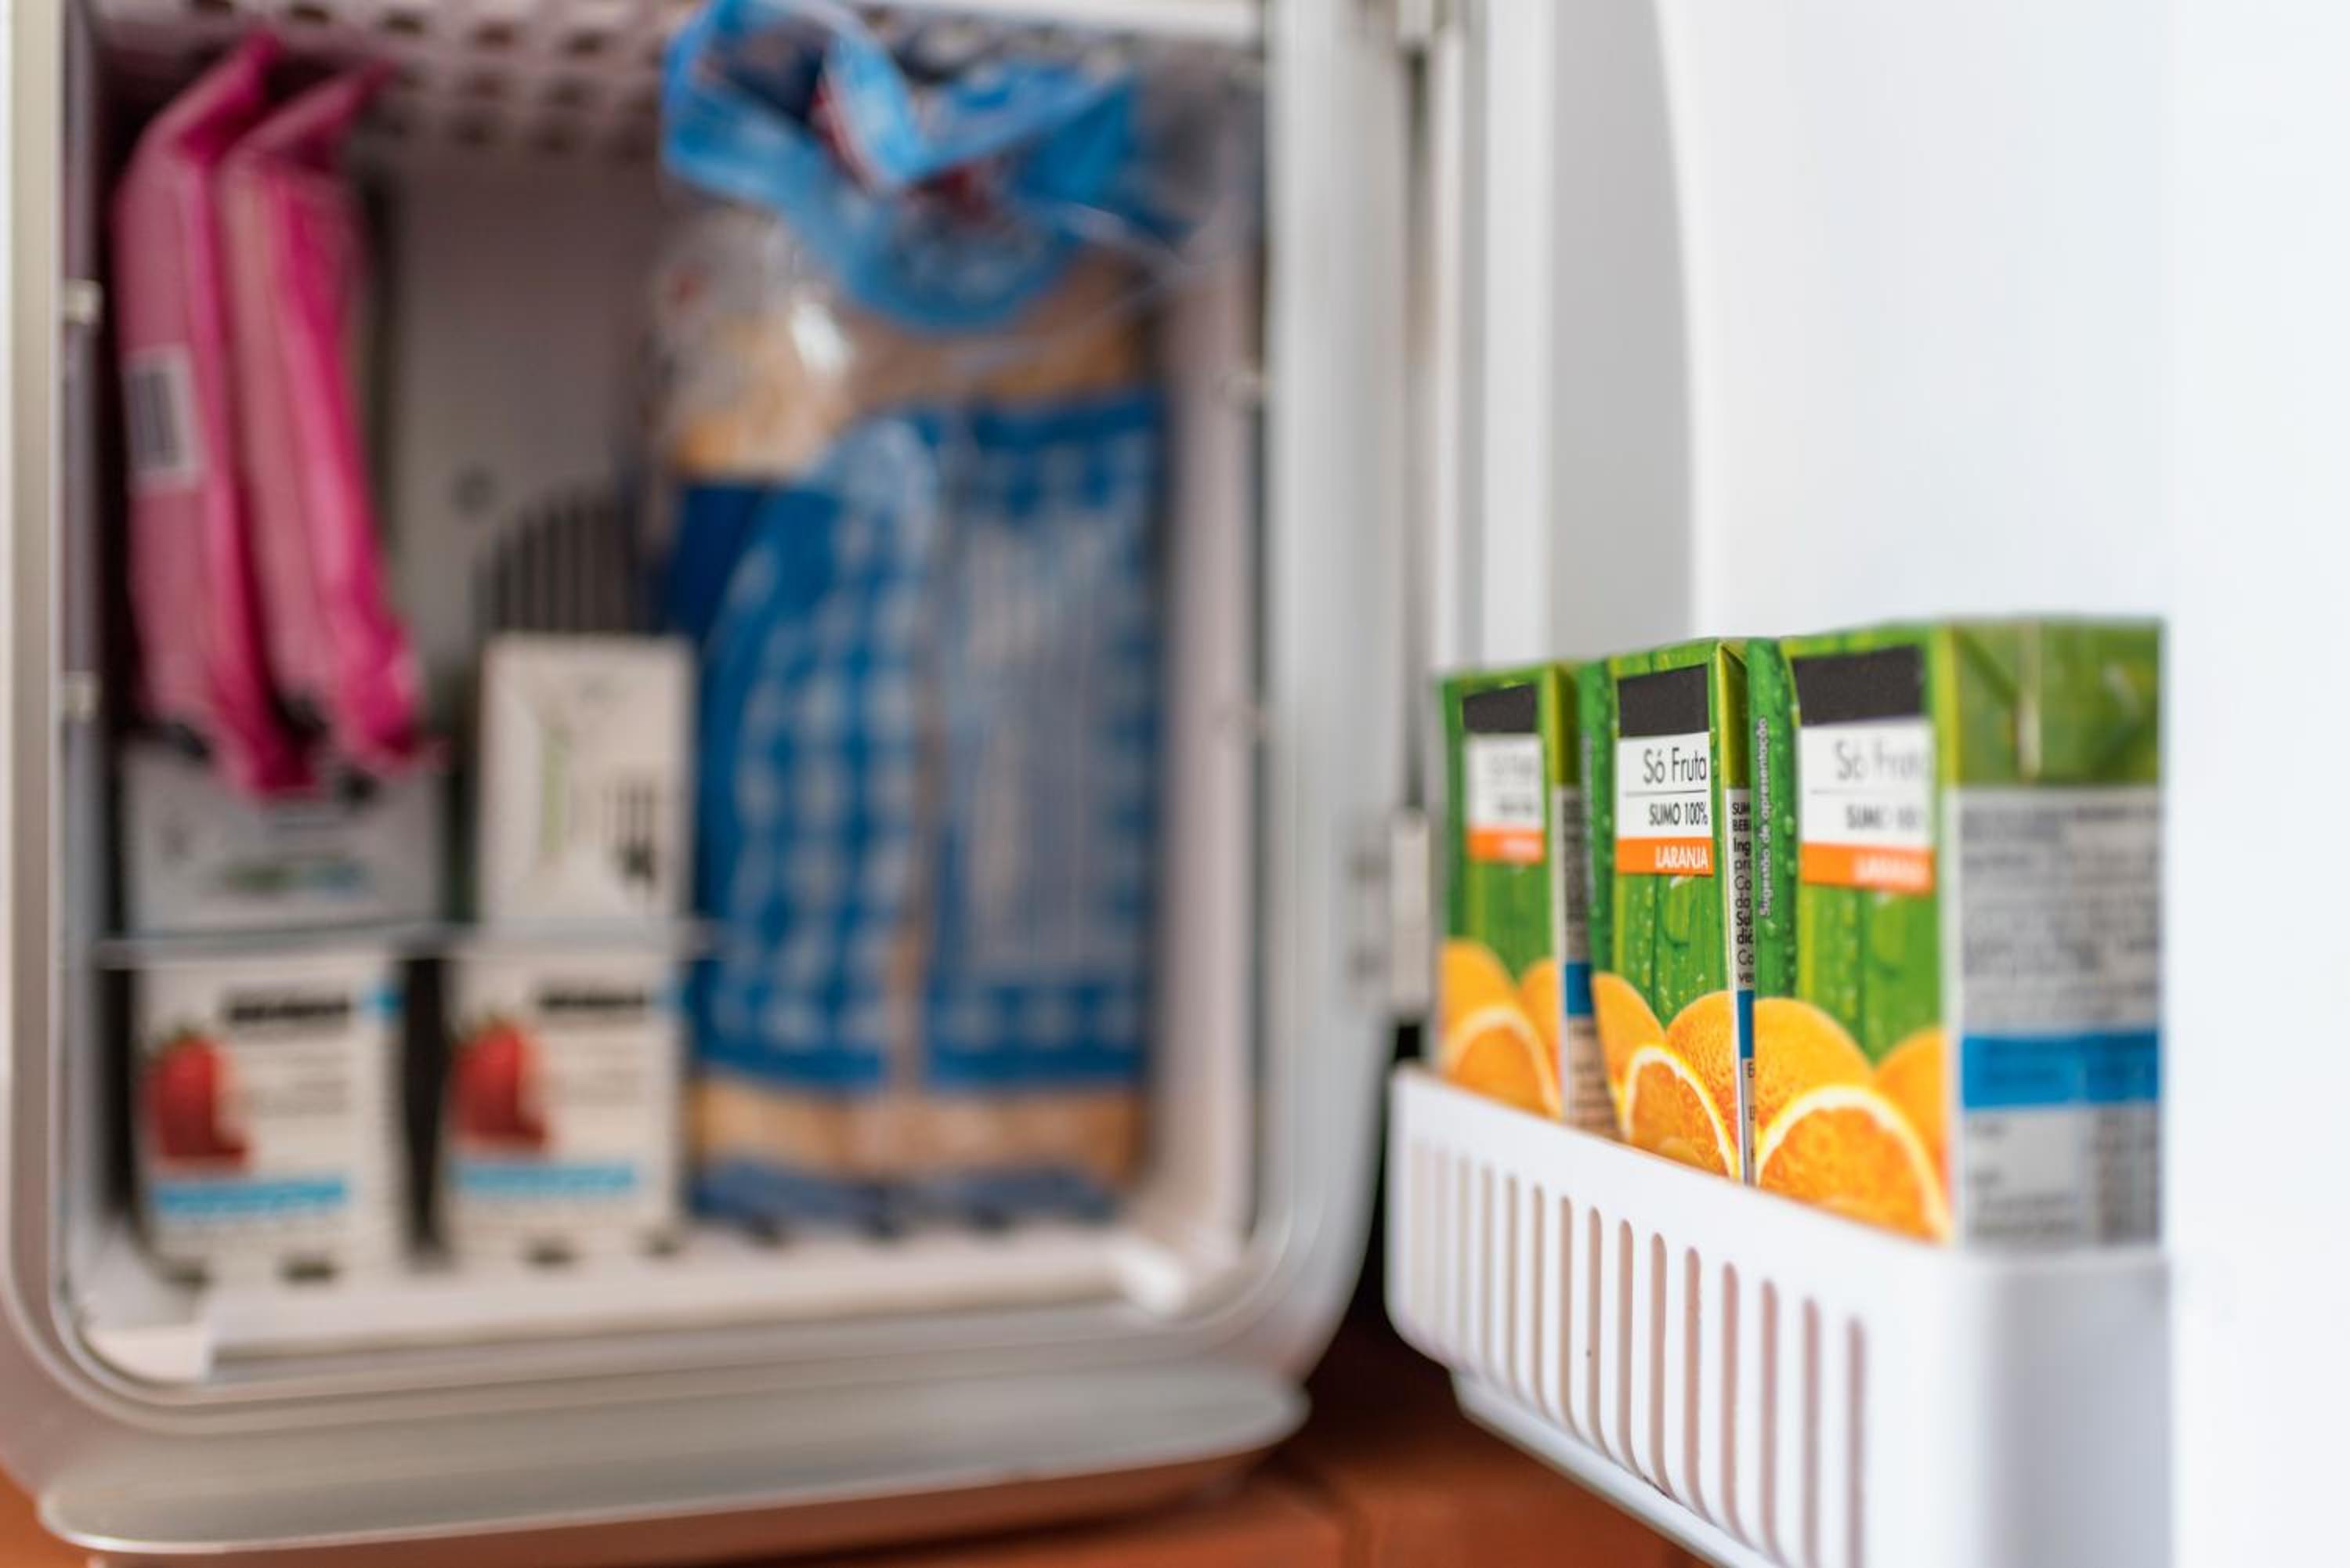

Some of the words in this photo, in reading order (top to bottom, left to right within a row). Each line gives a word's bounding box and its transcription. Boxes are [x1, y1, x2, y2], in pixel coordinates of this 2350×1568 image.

[1643, 748, 1665, 784] Só
[1672, 747, 1707, 782] Fruta
[1756, 717, 1771, 820] apresentação
[1648, 802, 1681, 826] SUMO
[1684, 801, 1708, 826] 100%
[1759, 825, 1770, 844] de
[1654, 844, 1708, 870] LARANJA
[1759, 849, 1772, 916] Sugestão
